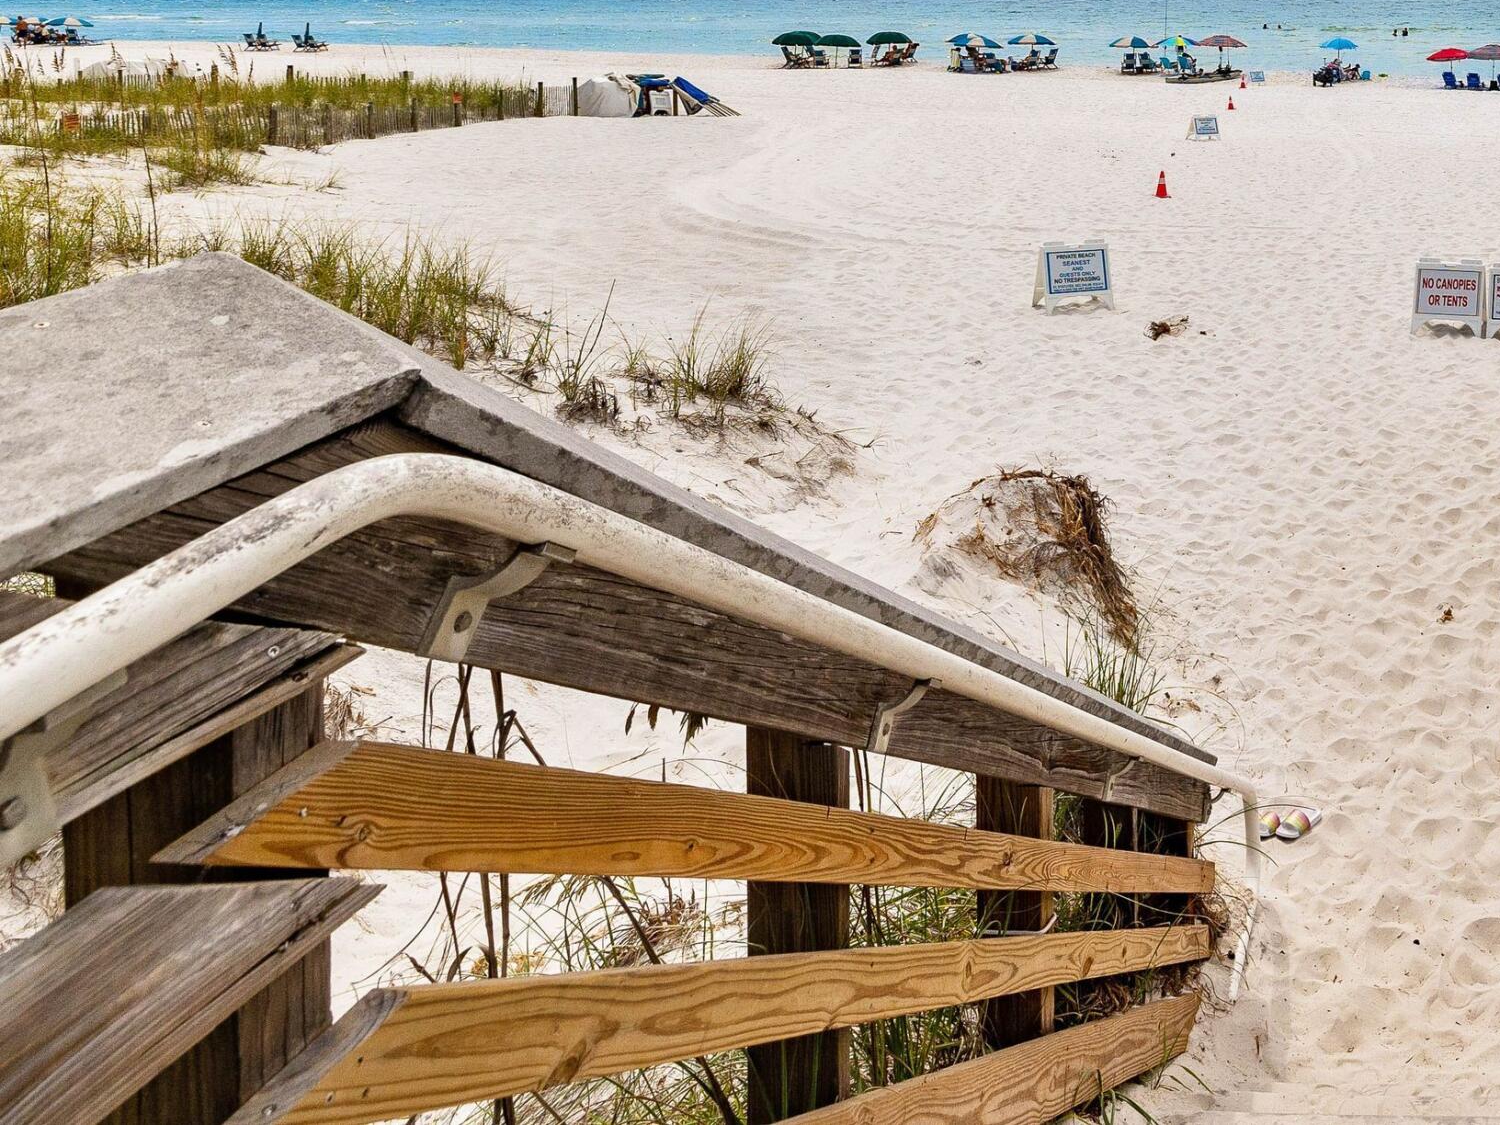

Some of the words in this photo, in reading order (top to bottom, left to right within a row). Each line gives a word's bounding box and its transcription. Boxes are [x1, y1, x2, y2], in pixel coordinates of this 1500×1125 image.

[1422, 277, 1434, 289] NO
[1436, 278, 1477, 291] CANOPIES
[1428, 294, 1440, 306] OR
[1442, 295, 1468, 307] TENTS
